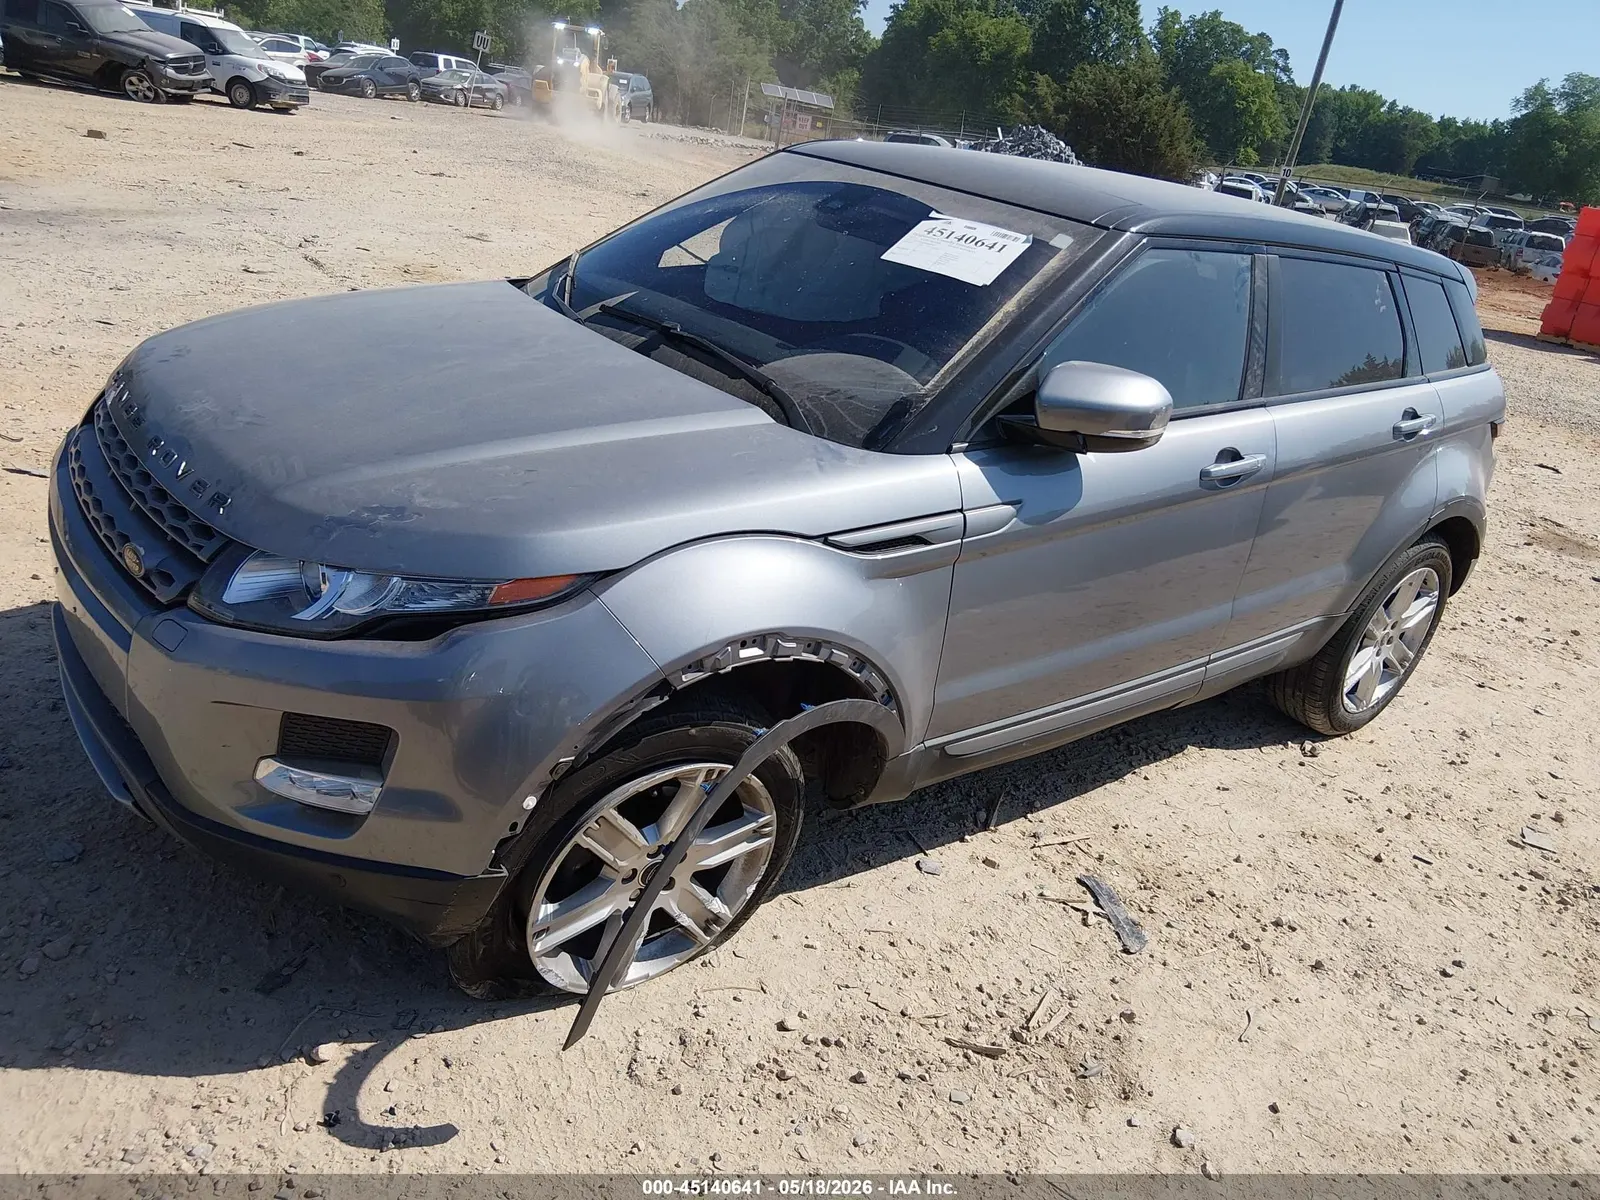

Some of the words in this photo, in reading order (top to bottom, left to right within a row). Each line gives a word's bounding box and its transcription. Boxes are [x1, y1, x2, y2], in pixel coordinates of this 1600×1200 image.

[1282, 168, 1292, 178] 10
[923, 226, 1008, 254] 45140641
[147, 434, 232, 515] ROVER
